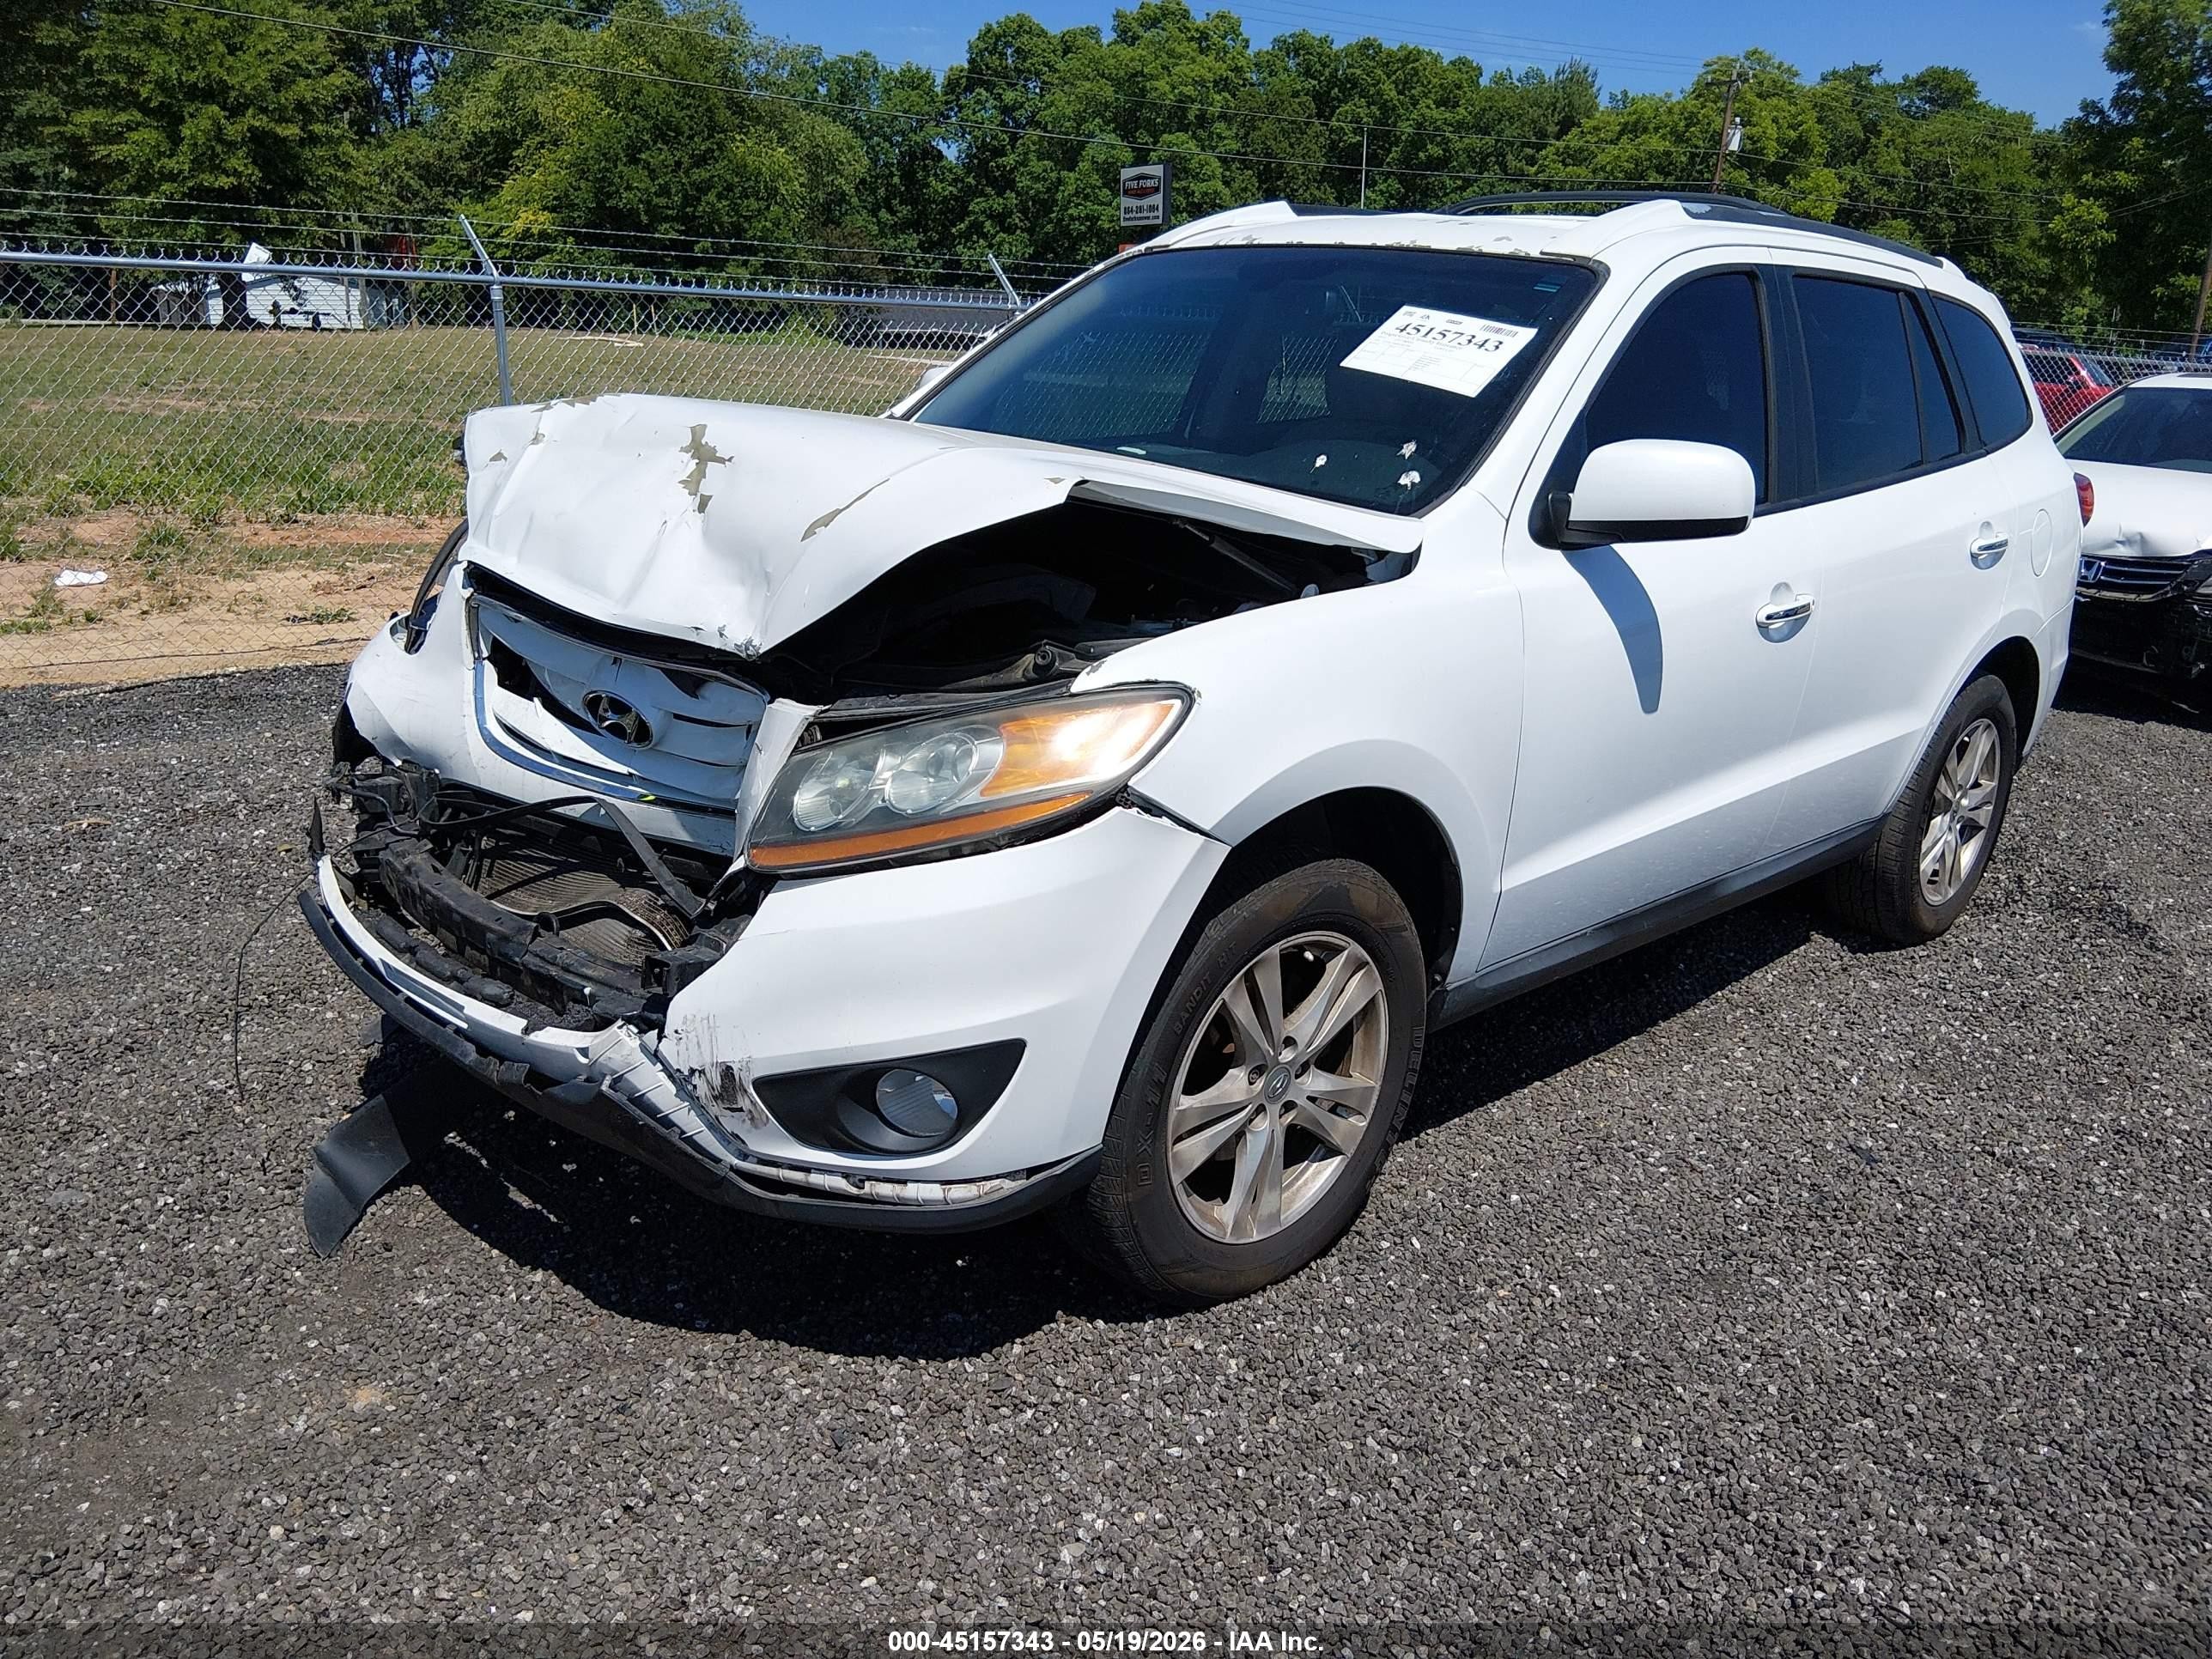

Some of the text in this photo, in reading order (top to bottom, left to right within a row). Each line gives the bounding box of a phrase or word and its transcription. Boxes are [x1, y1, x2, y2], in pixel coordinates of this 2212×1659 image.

[1125, 179, 1158, 190] FIVE FORKS
[1395, 322, 1504, 353] 45157343
[1173, 971, 1212, 1036] BANDIT
